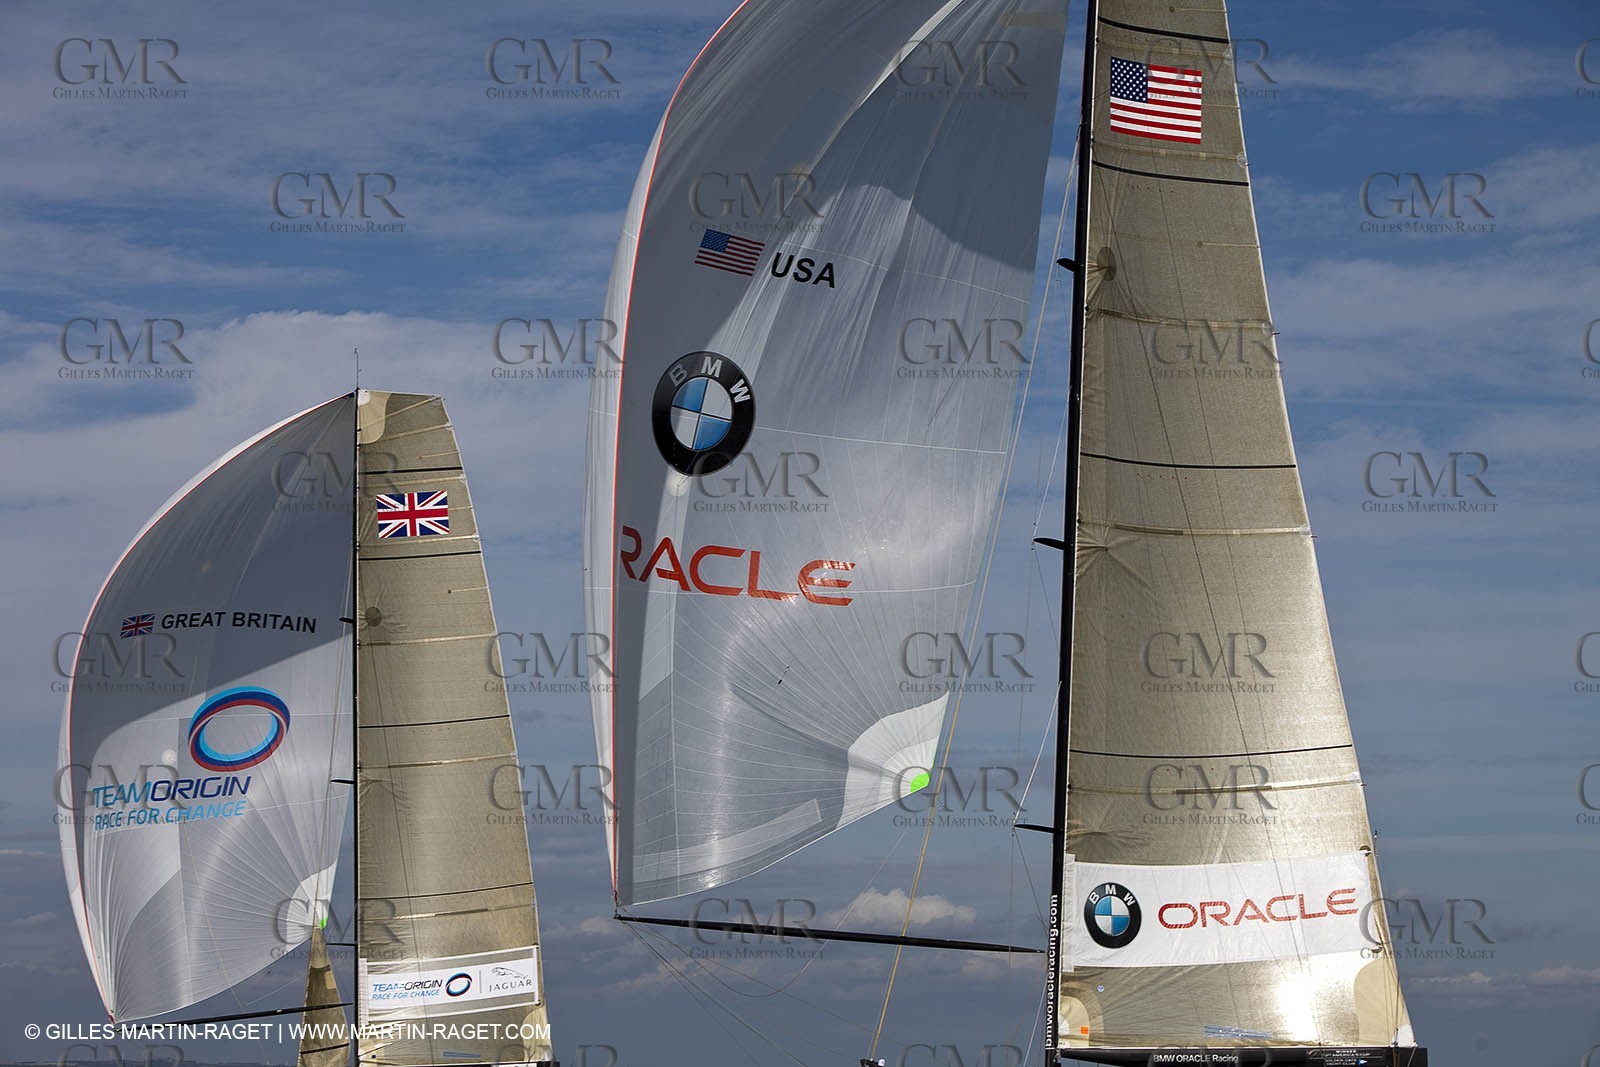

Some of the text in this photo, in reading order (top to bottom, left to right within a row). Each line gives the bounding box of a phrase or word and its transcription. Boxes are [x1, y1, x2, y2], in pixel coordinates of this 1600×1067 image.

[771, 252, 836, 289] USA
[668, 356, 752, 404] BMW
[620, 524, 857, 606] RACLE
[161, 611, 317, 634] GREAT BRITAIN
[93, 775, 252, 810] TEAMORIGIN
[95, 800, 248, 831] RACE FOR CHANGE
[1088, 883, 1137, 907] BMW
[1157, 886, 1360, 930] ORACLE
[488, 979, 533, 993] JAGUAR
[1044, 893, 1060, 1048] bmworacleracing.com
[371, 988, 440, 1001] RACE FOR CHANGE
[1152, 1053, 1239, 1064] BMW ORACLE Racing
